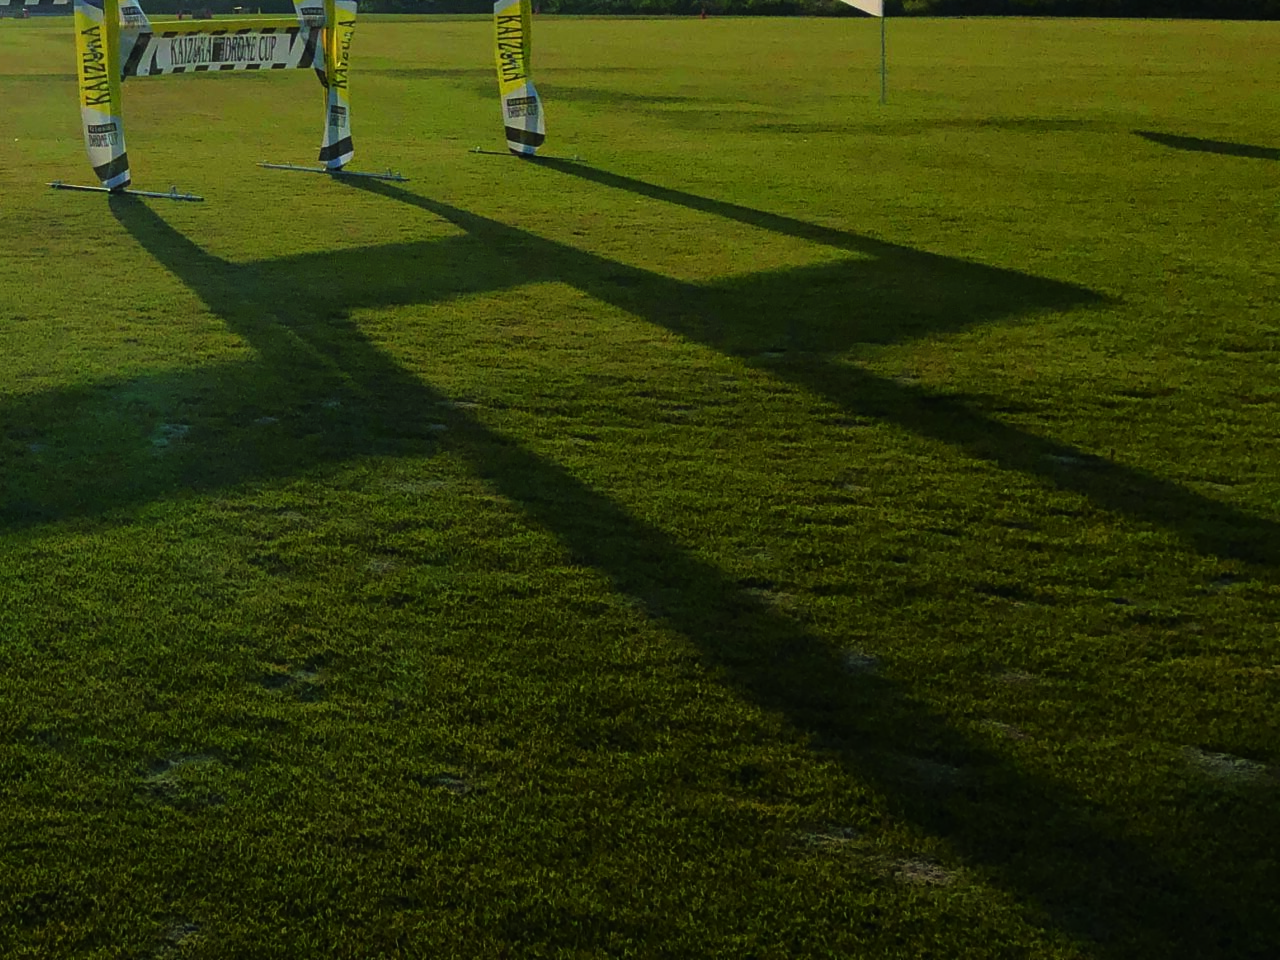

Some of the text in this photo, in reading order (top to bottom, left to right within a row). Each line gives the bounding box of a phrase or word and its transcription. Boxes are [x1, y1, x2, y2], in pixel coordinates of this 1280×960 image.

[81, 25, 112, 107] KAIZUKA
[170, 36, 213, 66] KAIZUKA
[223, 36, 256, 61] DRONE
[258, 36, 277, 61] CUP
[497, 15, 527, 83] KAIZUKA
